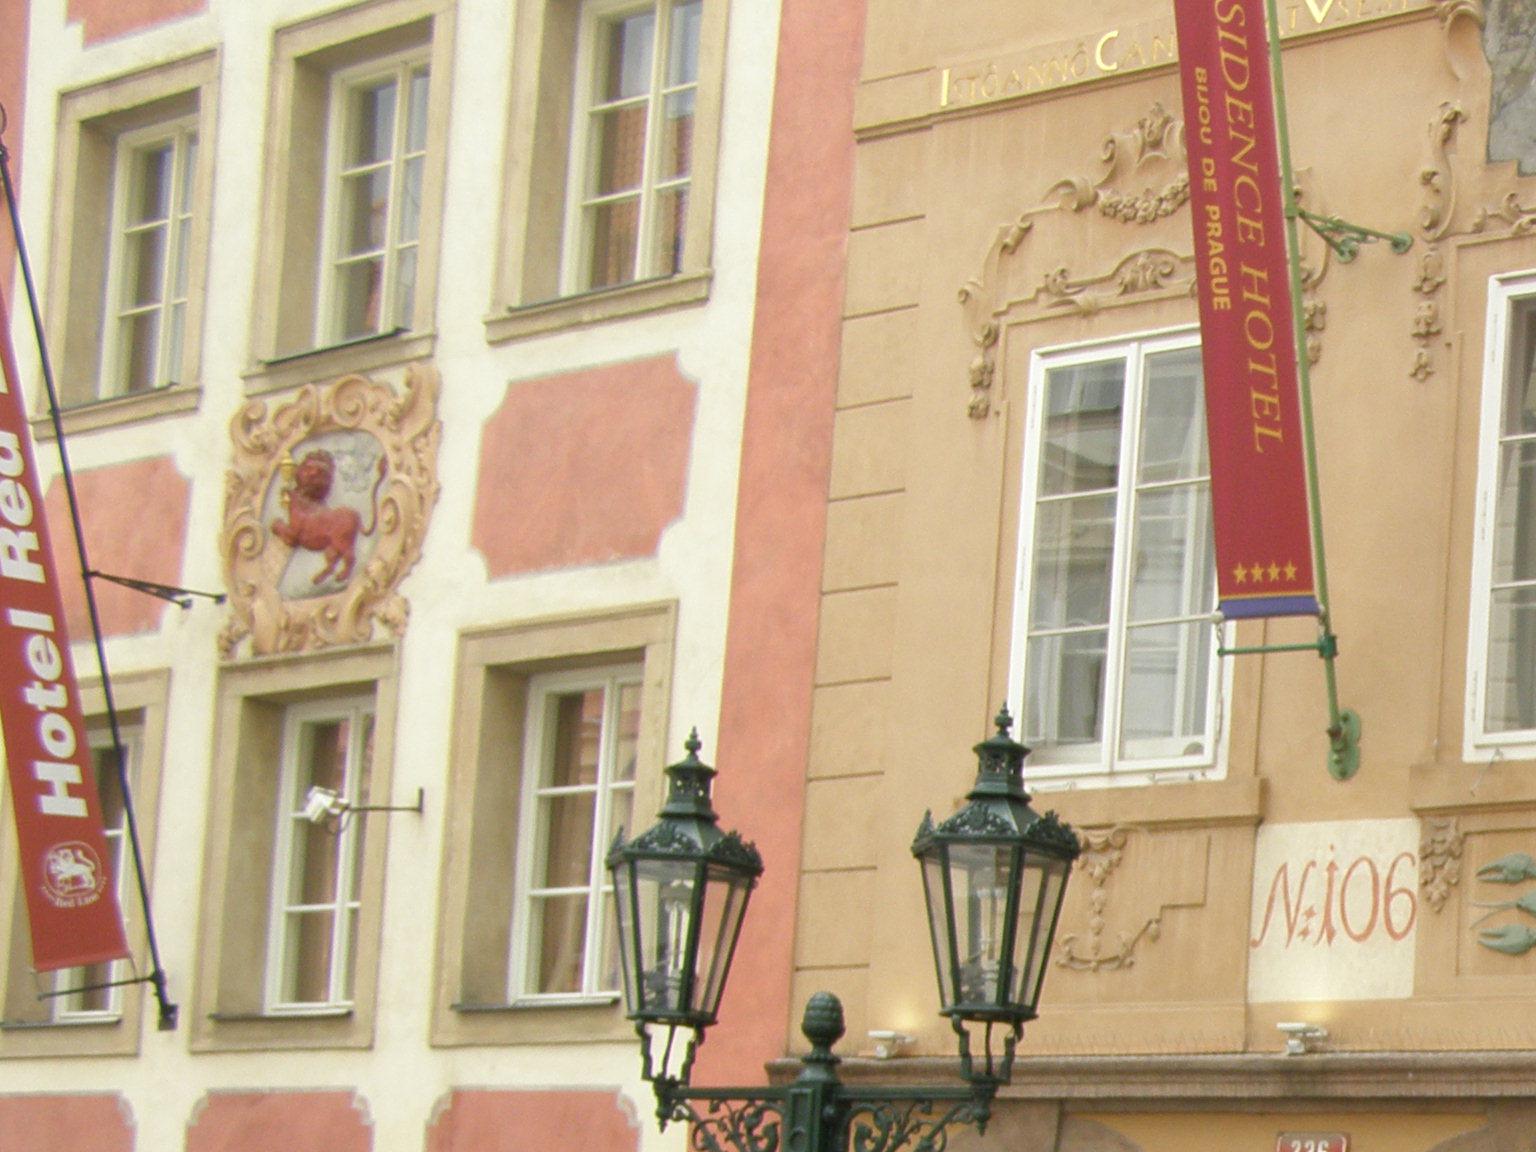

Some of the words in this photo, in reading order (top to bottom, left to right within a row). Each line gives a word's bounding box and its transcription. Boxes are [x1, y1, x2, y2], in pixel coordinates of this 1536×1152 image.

[1194, 66, 1213, 146] BIJOU
[1202, 156, 1218, 193] DE
[1206, 203, 1231, 312] PRAGUE
[1240, 261, 1284, 454] HOTEL
[9, 608, 89, 818] Hotel
